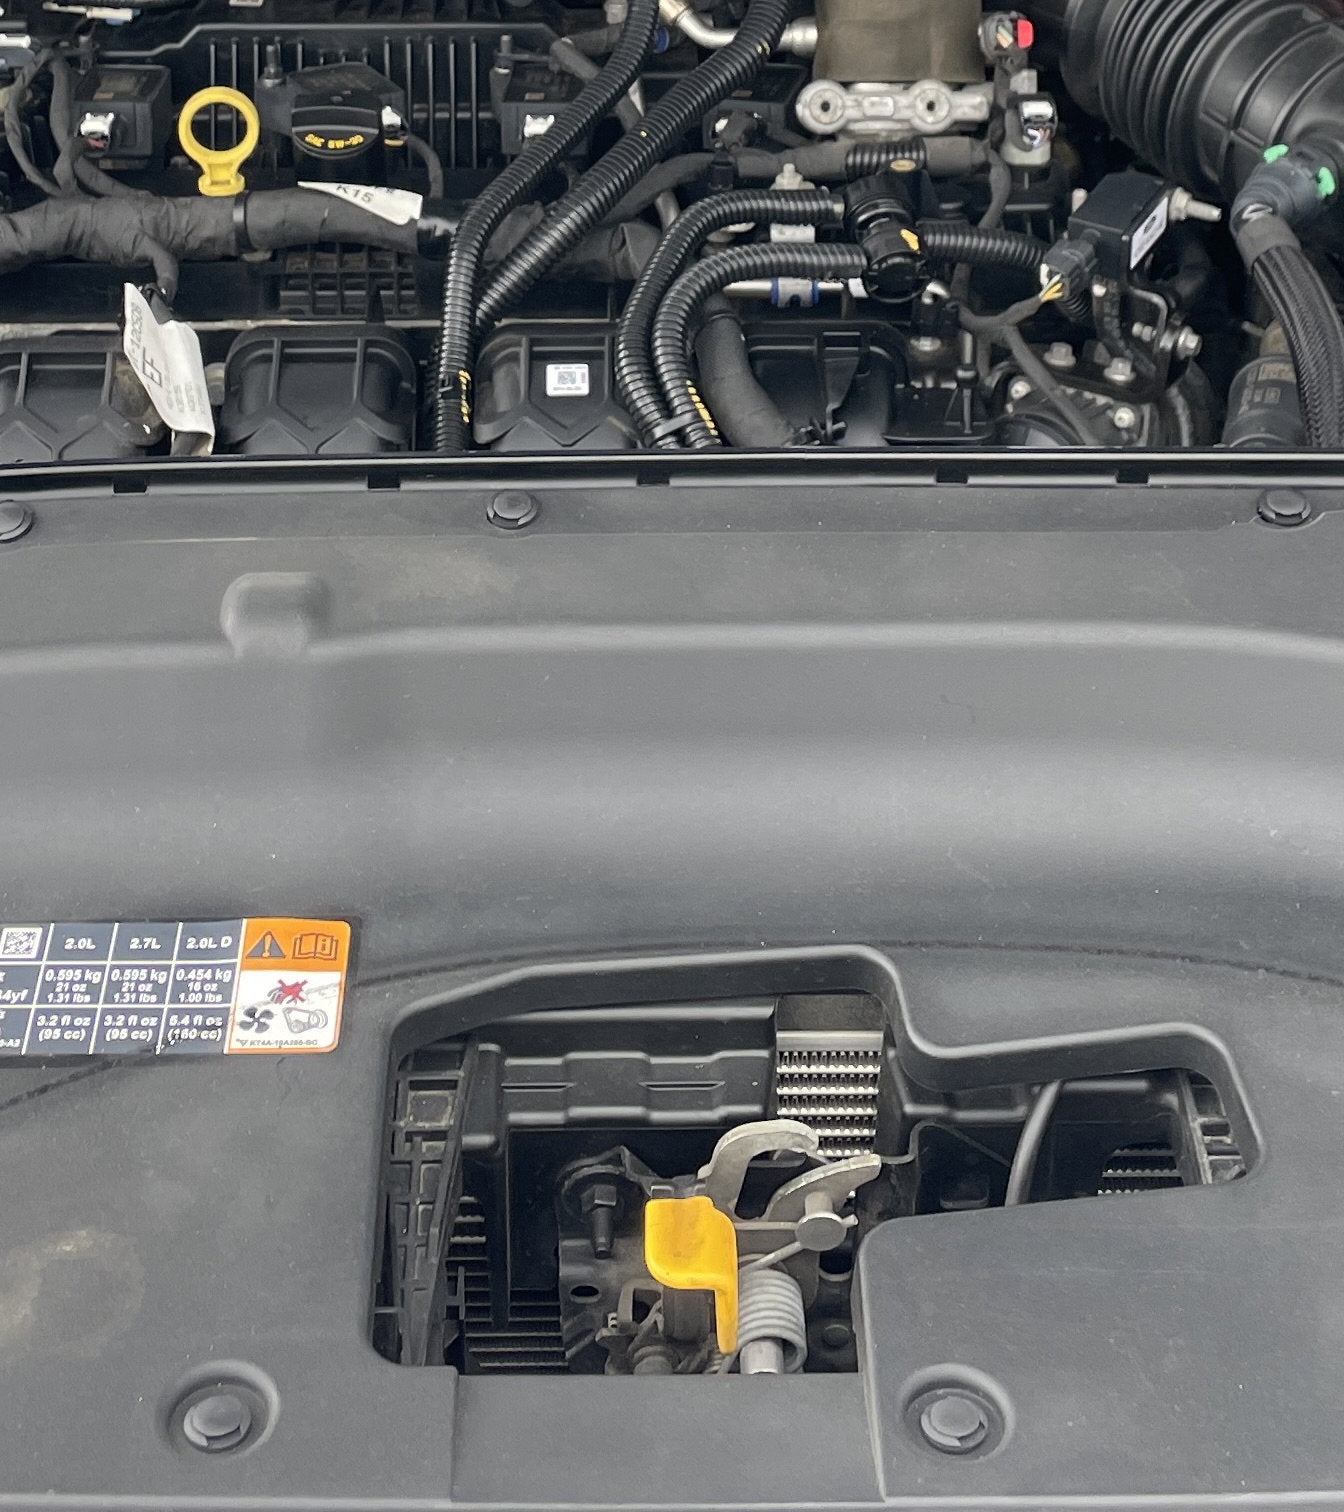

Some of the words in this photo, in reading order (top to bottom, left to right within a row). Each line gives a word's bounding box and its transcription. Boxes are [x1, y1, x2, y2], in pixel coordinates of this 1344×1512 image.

[64, 937, 96, 950] 2.0L
[129, 937, 161, 950] 2.7L
[186, 937, 217, 949] 2.0L
[220, 936, 233, 948] D
[44, 969, 82, 982] 0.595
[84, 969, 102, 984] kg
[110, 969, 148, 982] 0.595
[150, 969, 168, 984] kg
[176, 968, 212, 981] 0.454
[215, 969, 233, 983] kg
[55, 982, 70, 992] 21
[72, 983, 86, 992] oz
[121, 982, 135, 992] 21
[137, 983, 152, 992] oz
[203, 982, 218, 992] oz
[47, 993, 70, 1003] 1.31
[72, 992, 91, 1003] lbs
[113, 993, 136, 1003] 1.31
[138, 992, 157, 1003] lbs
[178, 992, 202, 1003] 1.00
[203, 992, 223, 1003] lbs
[36, 1015, 58, 1027] 3.2
[60, 1015, 71, 1027] fl
[73, 1017, 91, 1027] oz
[103, 1015, 126, 1027] 3.2
[127, 1015, 138, 1027] fl
[140, 1017, 159, 1027] oz
[192, 1015, 203, 1027] fl
[206, 1016, 223, 1027] oz
[38, 1028, 63, 1042] (95
[64, 1028, 86, 1042] cc)
[131, 1028, 154, 1042] cc)
[200, 1028, 222, 1042] cc)
